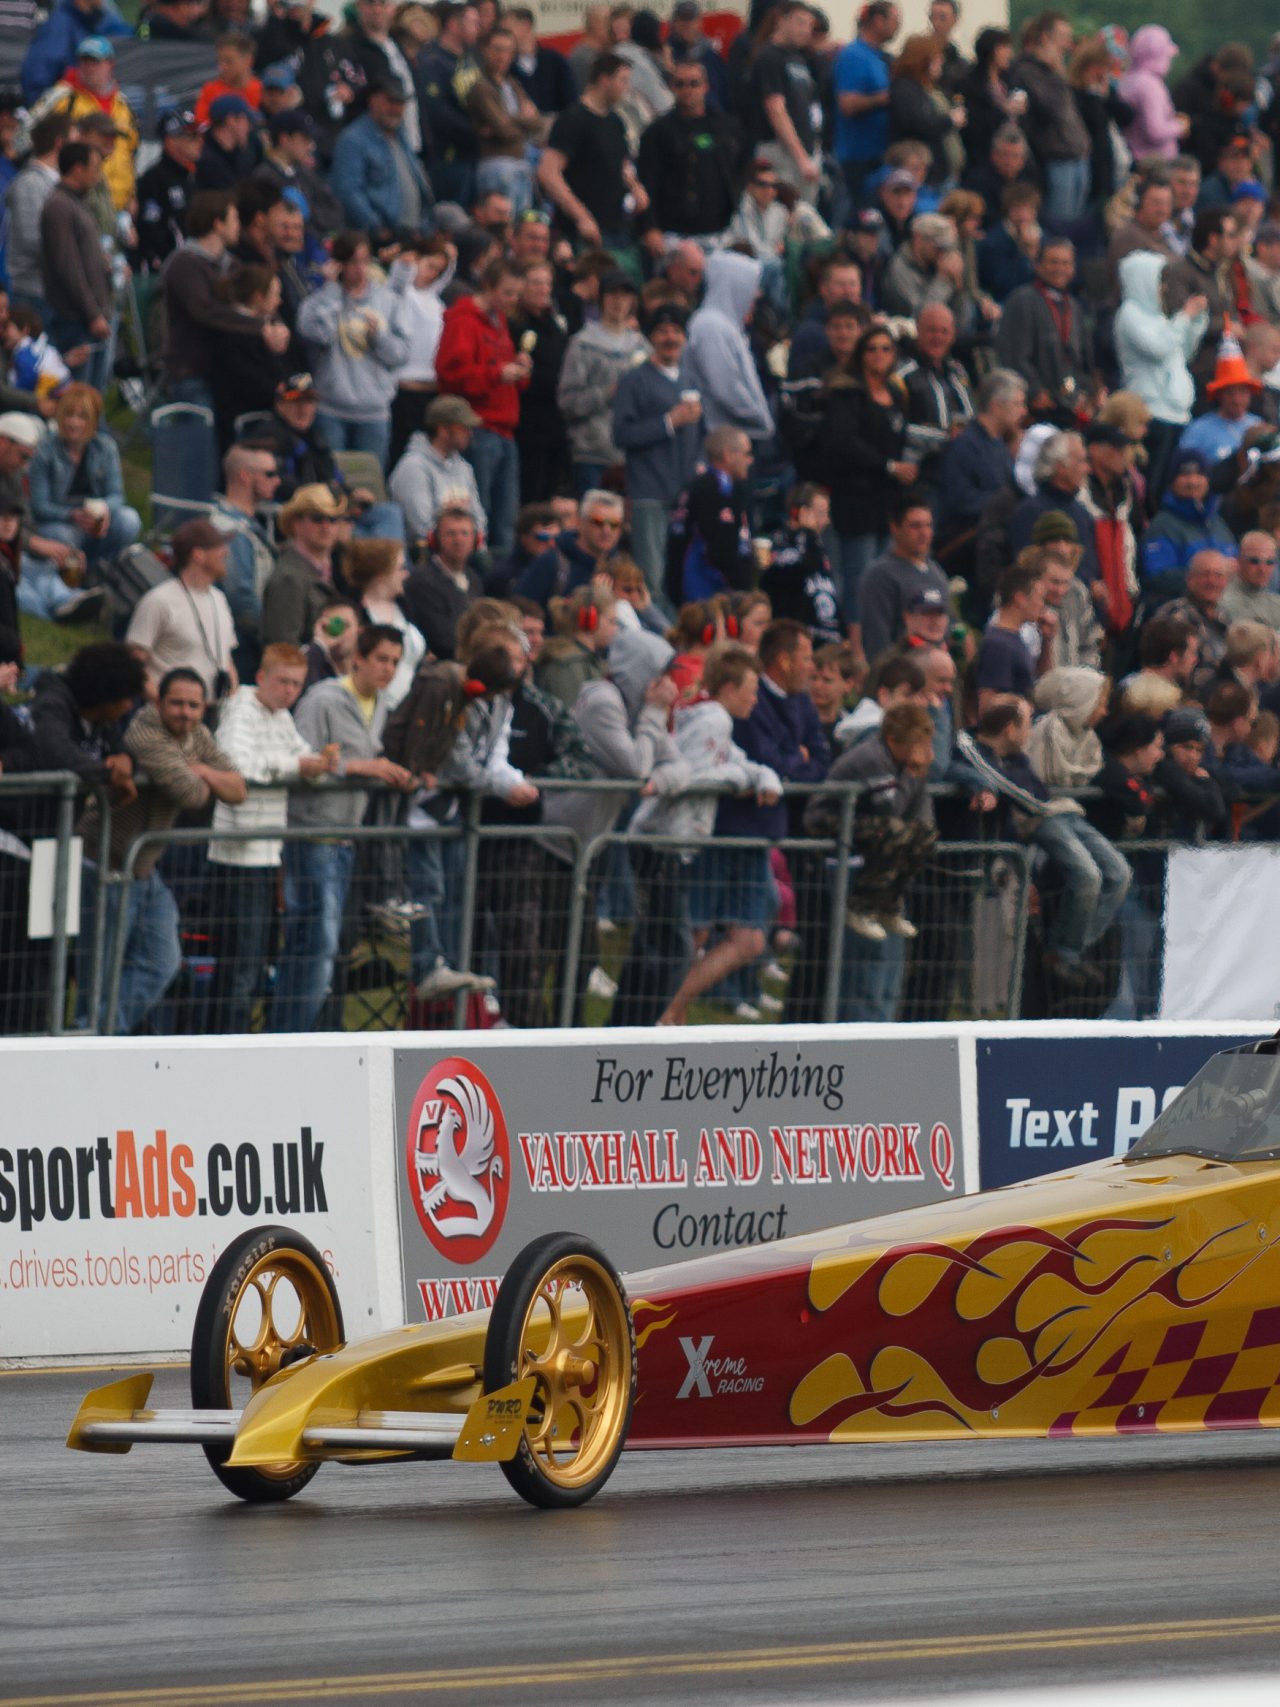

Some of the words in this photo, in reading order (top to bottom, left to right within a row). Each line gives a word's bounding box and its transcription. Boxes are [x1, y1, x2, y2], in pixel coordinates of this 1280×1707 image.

[591, 1058, 653, 1103] For
[661, 1051, 845, 1113] Everything
[1006, 1098, 1099, 1148] Text
[518, 1129, 688, 1192] VAUXHALL
[694, 1126, 763, 1187] AND
[769, 1122, 925, 1186] NETWORK
[929, 1121, 955, 1192] Q
[653, 1203, 788, 1249] Contact
[716, 1377, 765, 1394] RACING
